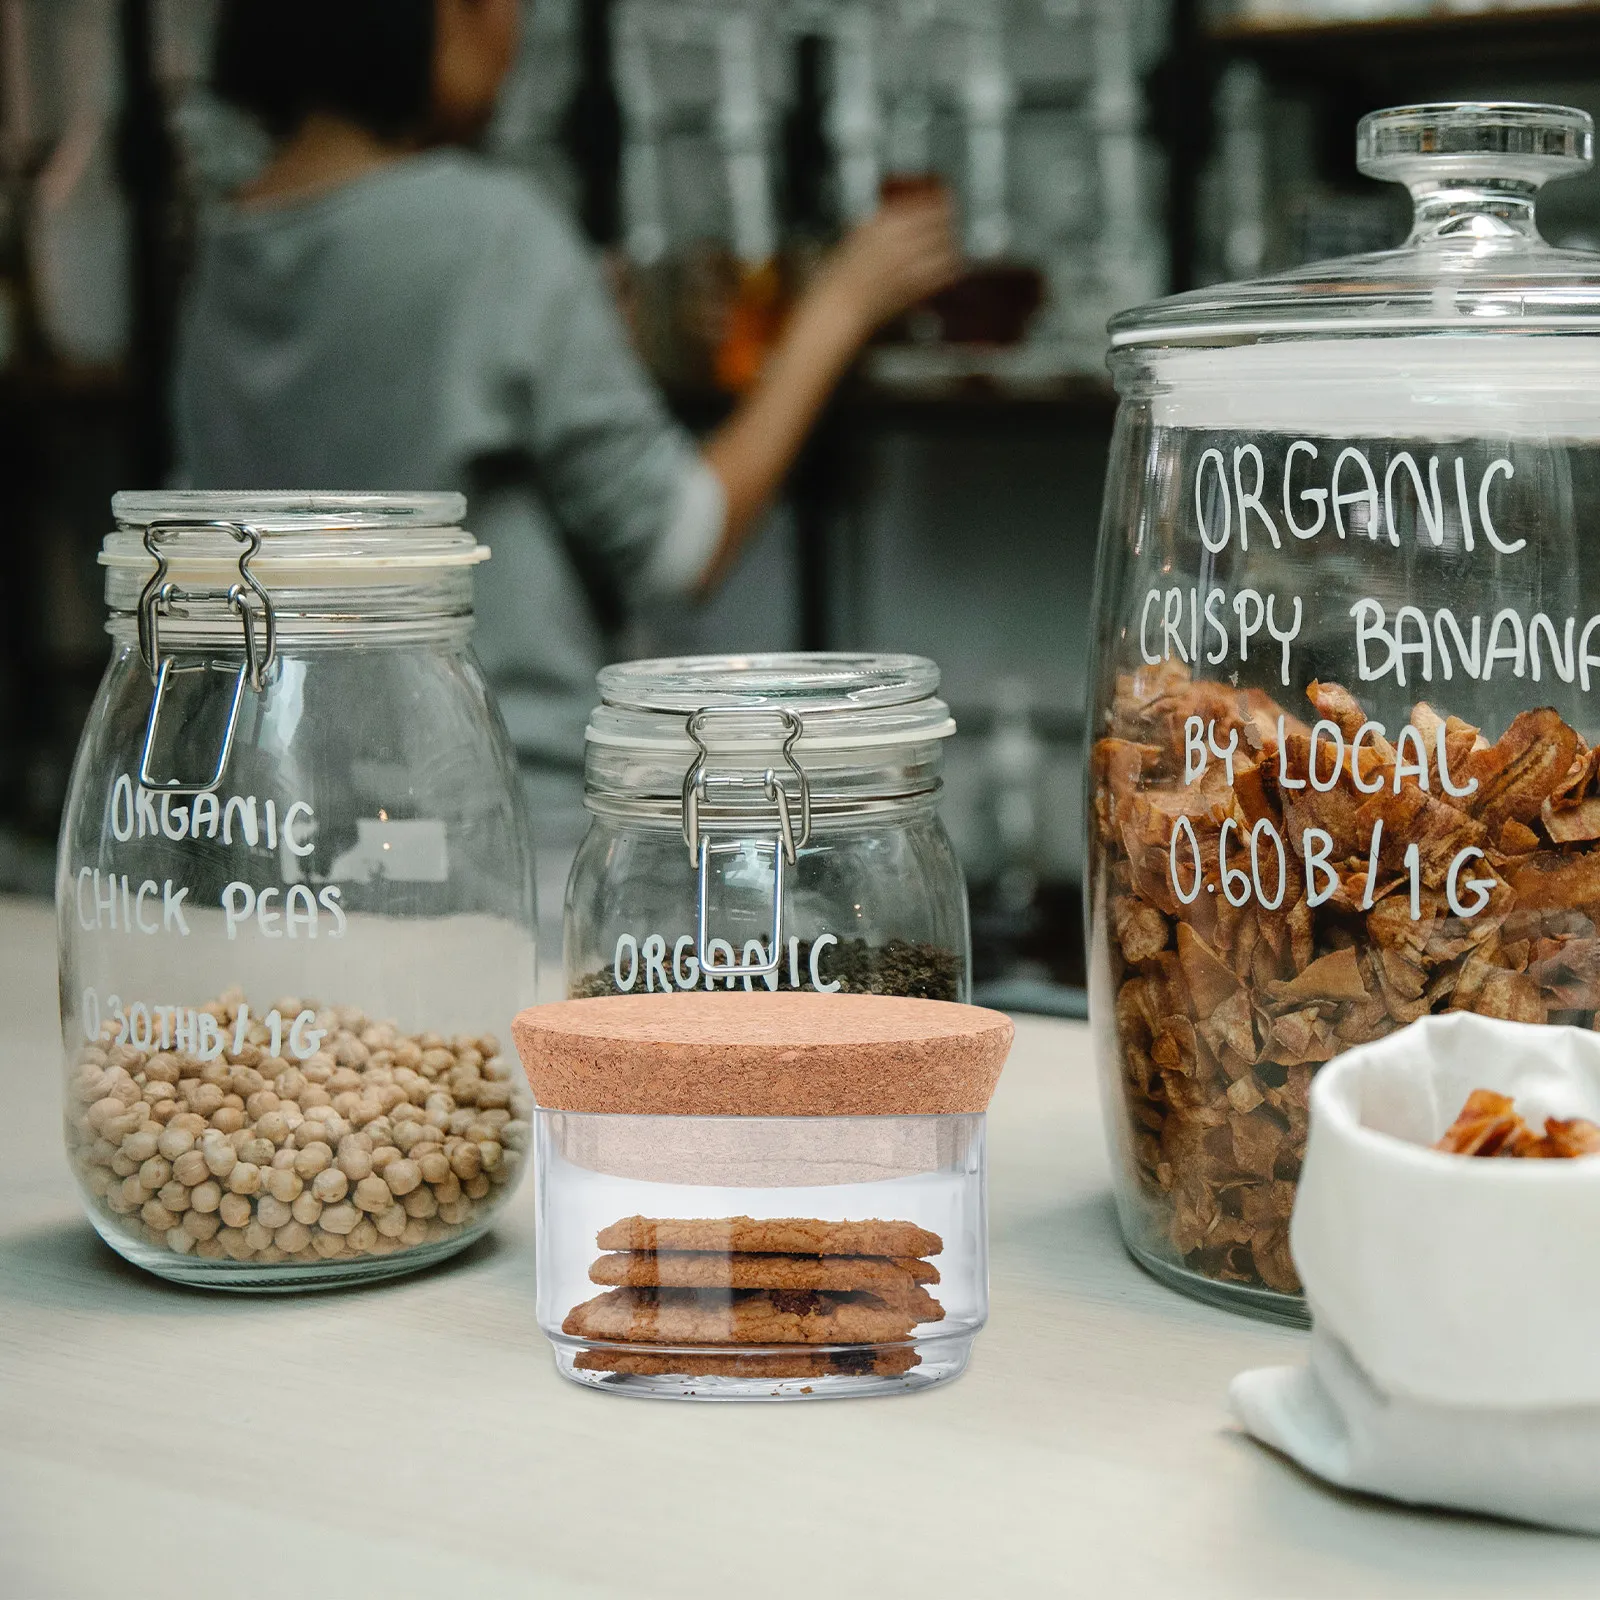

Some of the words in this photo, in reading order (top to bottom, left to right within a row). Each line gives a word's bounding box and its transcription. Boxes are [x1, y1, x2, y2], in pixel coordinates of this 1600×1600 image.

[1195, 441, 1526, 554] ORGANIC
[1140, 587, 1301, 686] CRISPY
[1184, 715, 1239, 786] BY
[1277, 714, 1479, 797] LOCAL
[112, 773, 315, 856] ORGANIC
[77, 866, 190, 936] CHICK
[221, 881, 347, 940] PEAS
[615, 933, 841, 993] ORGANIC
